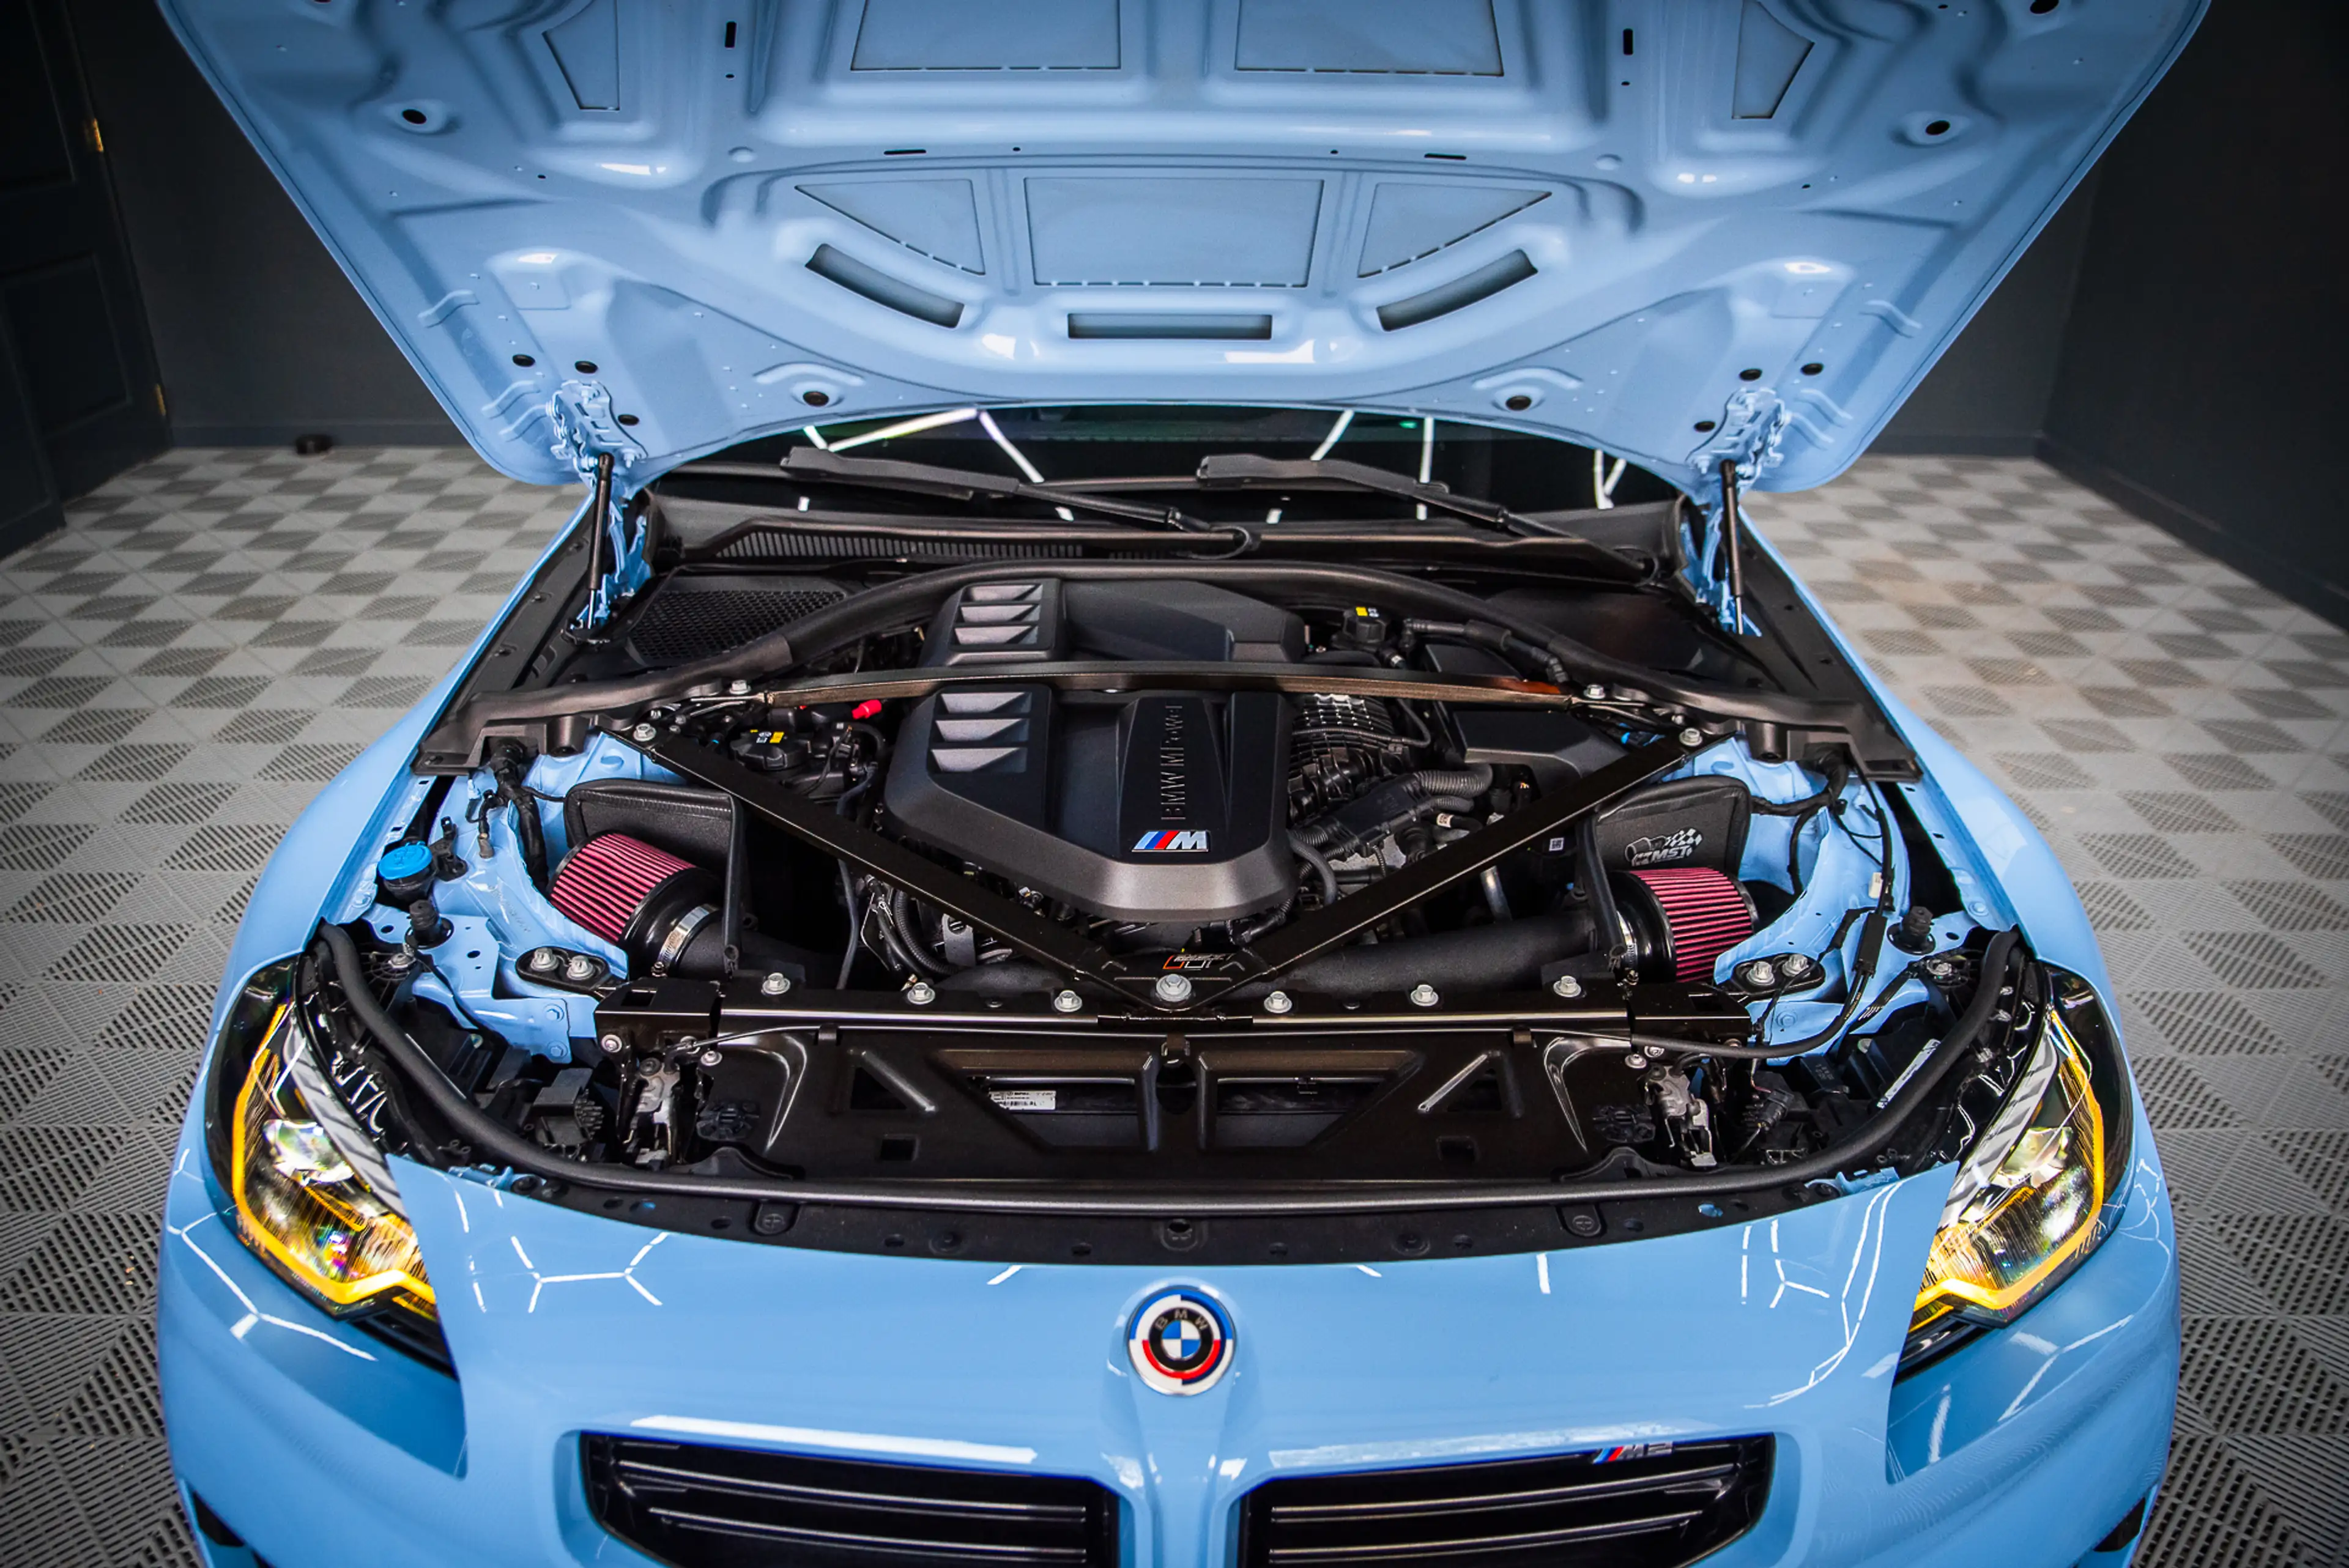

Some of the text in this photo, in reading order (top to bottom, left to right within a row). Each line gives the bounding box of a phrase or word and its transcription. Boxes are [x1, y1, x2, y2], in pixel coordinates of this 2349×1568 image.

[1160, 771, 1186, 820] BMW
[1154, 1308, 1209, 1331] BMW
[1616, 1442, 1672, 1461] M2
